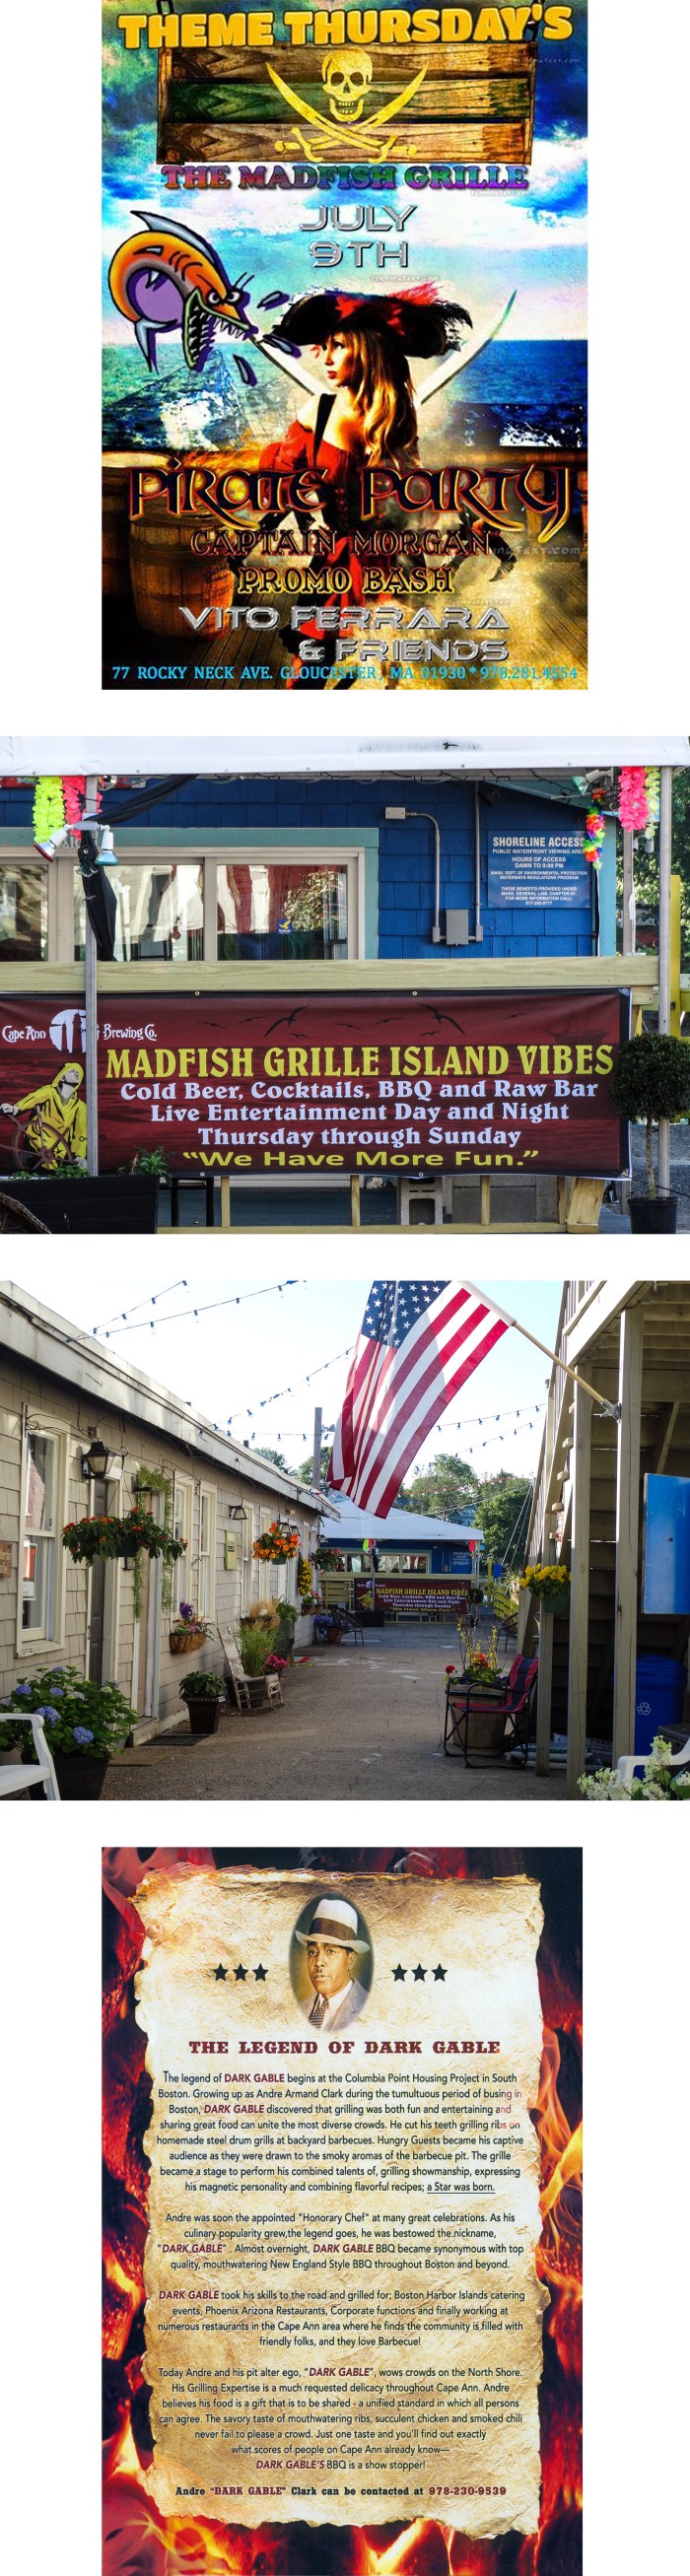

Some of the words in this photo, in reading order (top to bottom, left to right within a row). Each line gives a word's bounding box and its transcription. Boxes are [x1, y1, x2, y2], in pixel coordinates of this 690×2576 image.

[117, 10, 275, 49] THEME
[283, 5, 574, 45] THURSDAY'S
[162, 165, 231, 190] THE
[240, 165, 396, 189] MADFISH
[404, 165, 530, 189] GRILLE
[300, 205, 418, 232] JULY
[309, 240, 409, 268] 9TH
[190, 529, 335, 556] CAPTAIN
[341, 529, 491, 556] MORGAN
[238, 567, 352, 594] PROMO
[362, 567, 456, 593] BASH
[179, 605, 279, 631] VITO
[291, 605, 510, 631] FERRARA
[299, 639, 324, 662] &
[334, 638, 510, 662] FRIENDS
[111, 666, 130, 680] 77
[137, 666, 186, 680] ROCKY
[194, 666, 234, 679] NECK
[241, 666, 273, 679] AVE.
[390, 665, 414, 679] MA
[493, 837, 545, 847] SHORELINE
[548, 837, 586, 847] ACCESS
[2, 1025, 26, 1043] Cape
[104, 1024, 143, 1041] Brewing
[144, 1024, 158, 1041] Co.
[105, 1048, 254, 1078] MADFISH
[263, 1047, 379, 1077] GRILLE
[390, 1046, 509, 1076] ISLAND
[518, 1045, 613, 1075] VIBES
[120, 1082, 175, 1100] Cold
[184, 1082, 243, 1101] Beer,
[250, 1081, 371, 1100] Cocktails,
[379, 1081, 432, 1102] BBQ
[440, 1080, 486, 1098] and
[495, 1080, 546, 1098] Raw
[554, 1080, 598, 1097] Bar
[151, 1105, 199, 1121] Live
[207, 1104, 386, 1121] Entertainment
[394, 1104, 441, 1123] Day
[448, 1103, 494, 1119] and
[503, 1102, 570, 1123] Night
[198, 1127, 313, 1148] Thursday
[321, 1127, 420, 1148] through
[428, 1127, 520, 1147] Sunday
[264, 1152, 344, 1166] Have
[356, 1151, 444, 1166] More
[189, 2041, 229, 2054] THE
[239, 2041, 318, 2054] LEGEND
[328, 2041, 355, 2054] OF
[365, 2041, 422, 2054] DARK
[432, 2041, 501, 2054] GABLE
[164, 2071, 178, 2083] The
[181, 2073, 210, 2084] legend
[213, 2073, 222, 2082] of
[225, 2073, 250, 2082] DARK
[254, 2073, 285, 2082] GABLE
[288, 2073, 315, 2084] begins
[328, 2073, 342, 2082] the
[345, 2073, 385, 2082] Columbia
[388, 2073, 410, 2082] Point
[412, 2073, 447, 2084] Housing
[450, 2073, 479, 2084] Project
[482, 2073, 489, 2082] in
[493, 2073, 517, 2082] South
[171, 2260, 200, 2271] quality,
[203, 2260, 267, 2271] mouthwatering
[270, 2260, 290, 2269] New
[292, 2260, 327, 2271] England
[329, 2260, 350, 2271] Style
[353, 2260, 373, 2269] BBQ
[375, 2260, 422, 2271] throughout
[425, 2260, 454, 2269] Boston
[457, 2260, 473, 2269] and
[475, 2260, 510, 2271] beyond.
[256, 2461, 283, 2470] DARK
[286, 2461, 324, 2470] GABLE'S
[327, 2461, 346, 2470] BBQ
[349, 2461, 355, 2470] is
[366, 2461, 386, 2470] show
[389, 2461, 426, 2472] stopper!
